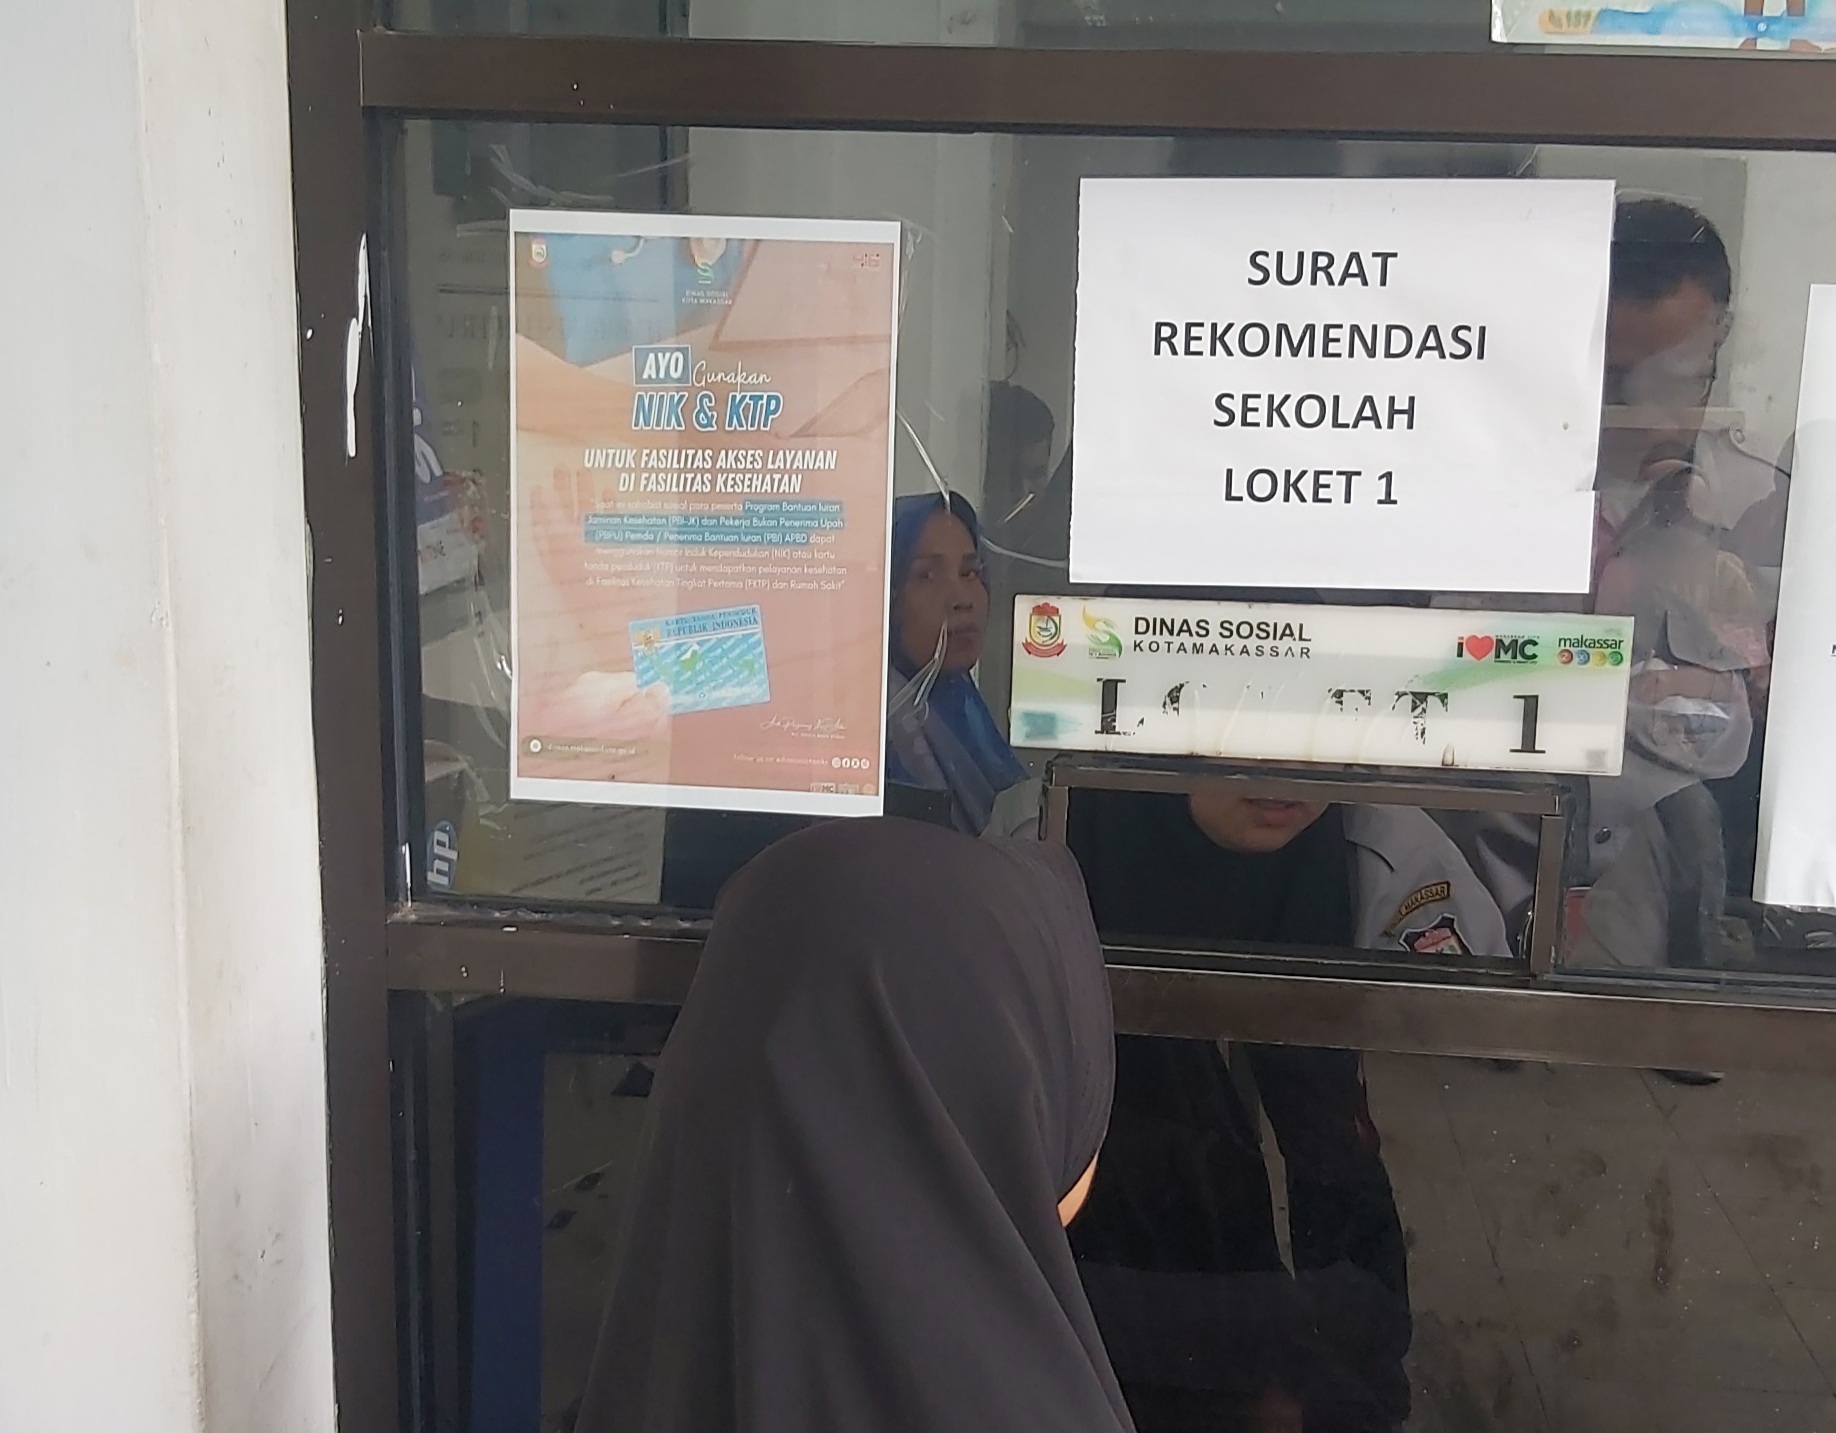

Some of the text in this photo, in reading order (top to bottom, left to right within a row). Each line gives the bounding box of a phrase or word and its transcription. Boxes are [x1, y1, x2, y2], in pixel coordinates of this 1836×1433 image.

[1247, 250, 1398, 287] SURAT
[1153, 321, 1487, 360] REKOMENDASI
[643, 351, 772, 393] AYO Gunakan
[632, 390, 783, 432] NIK & KTP
[1213, 393, 1416, 430] SEKOLAH
[584, 448, 838, 470] UNTUK FASILITAS AKSES LAYANAN
[619, 472, 803, 493] DI FASILITAS KESEHATAN
[1225, 468, 1399, 505] LOKET 1
[745, 501, 780, 513] Program
[782, 501, 817, 512] Bantuan
[701, 516, 718, 526] dan
[752, 517, 777, 527] Bukan
[820, 518, 843, 530] Upah
[704, 532, 739, 542] Bantuan
[784, 533, 808, 543] APBD
[772, 580, 789, 590] dan
[791, 580, 818, 590] Rumah
[1134, 616, 1312, 642] DINAS SOSIAL
[1558, 634, 1624, 650] makassar
[1509, 694, 1547, 755] 1
[427, 830, 459, 886] hp
